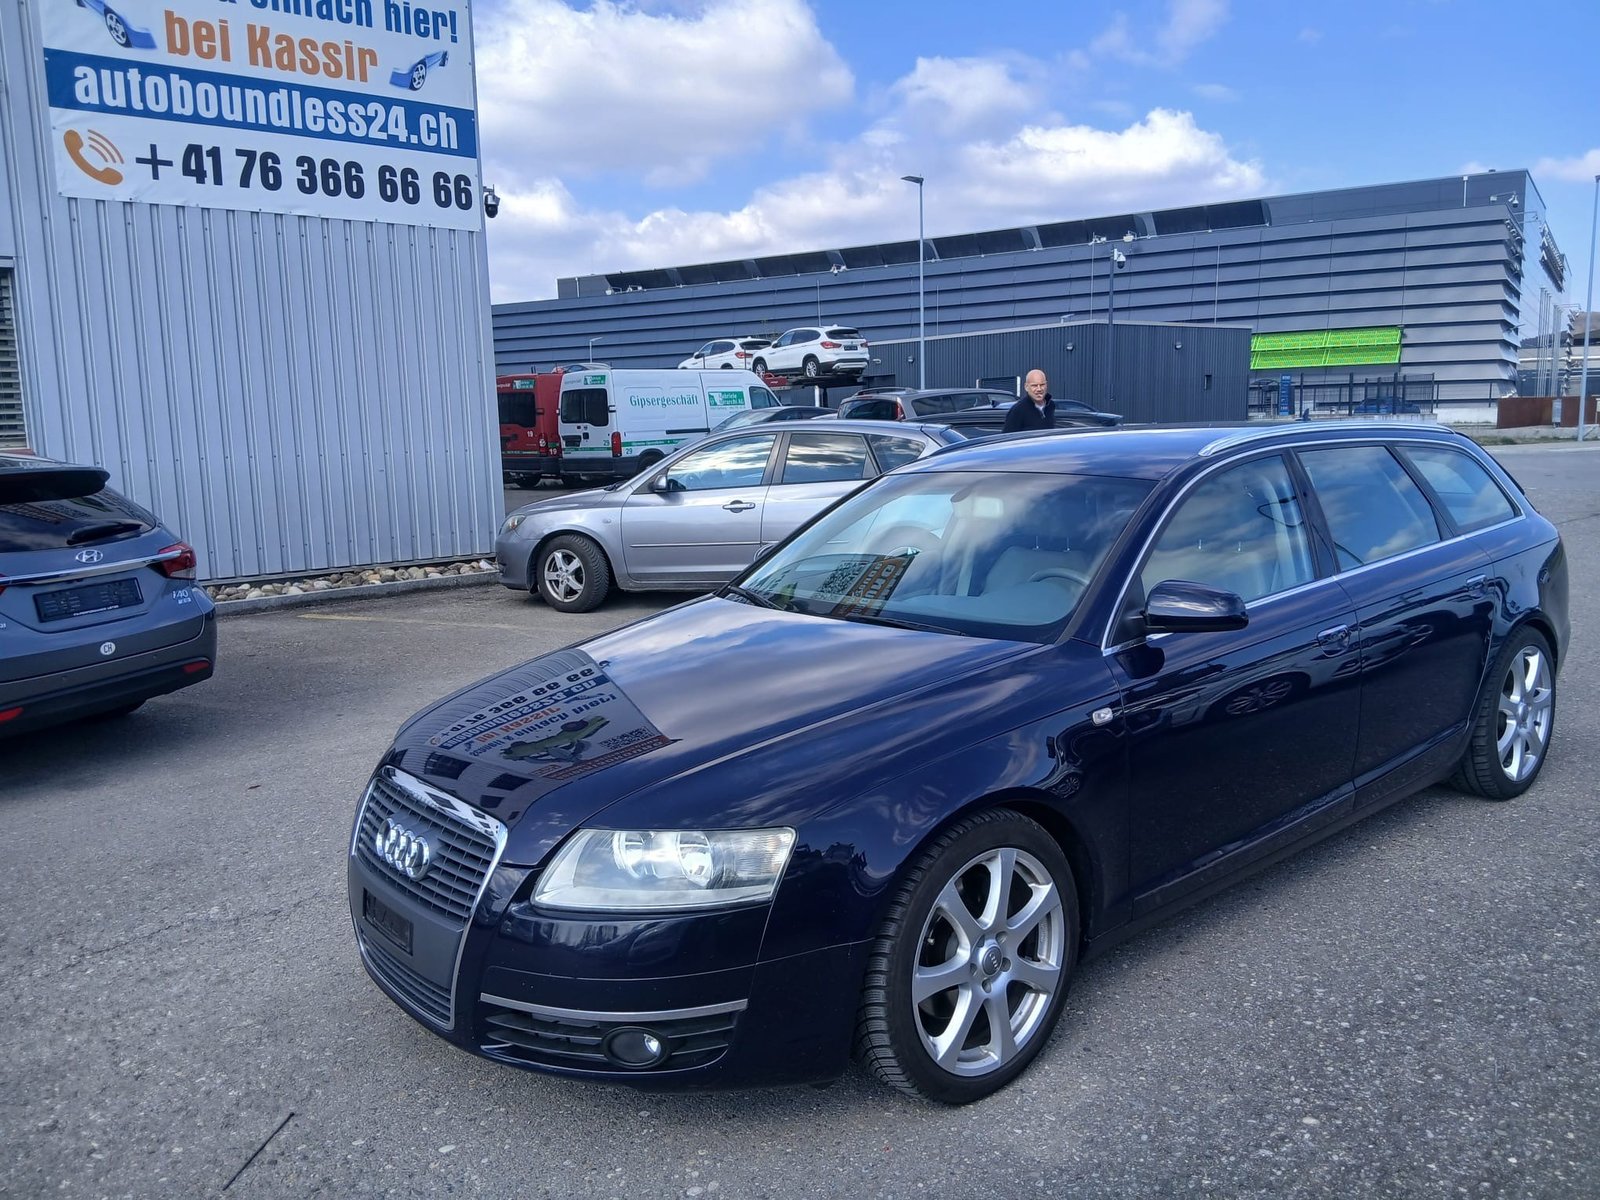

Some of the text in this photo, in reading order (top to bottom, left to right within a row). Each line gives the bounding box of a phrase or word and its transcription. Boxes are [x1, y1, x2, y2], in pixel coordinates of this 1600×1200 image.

[164, 10, 378, 83] bei Kassir
[384, 0, 458, 43] hier!
[73, 64, 459, 150] autoboundless24.ch
[235, 148, 282, 191] 76
[296, 155, 365, 199] 366
[378, 164, 421, 205] 66
[433, 171, 473, 210] 66
[629, 394, 699, 408] Gipsergeschäft
[526, 430, 534, 438] 19
